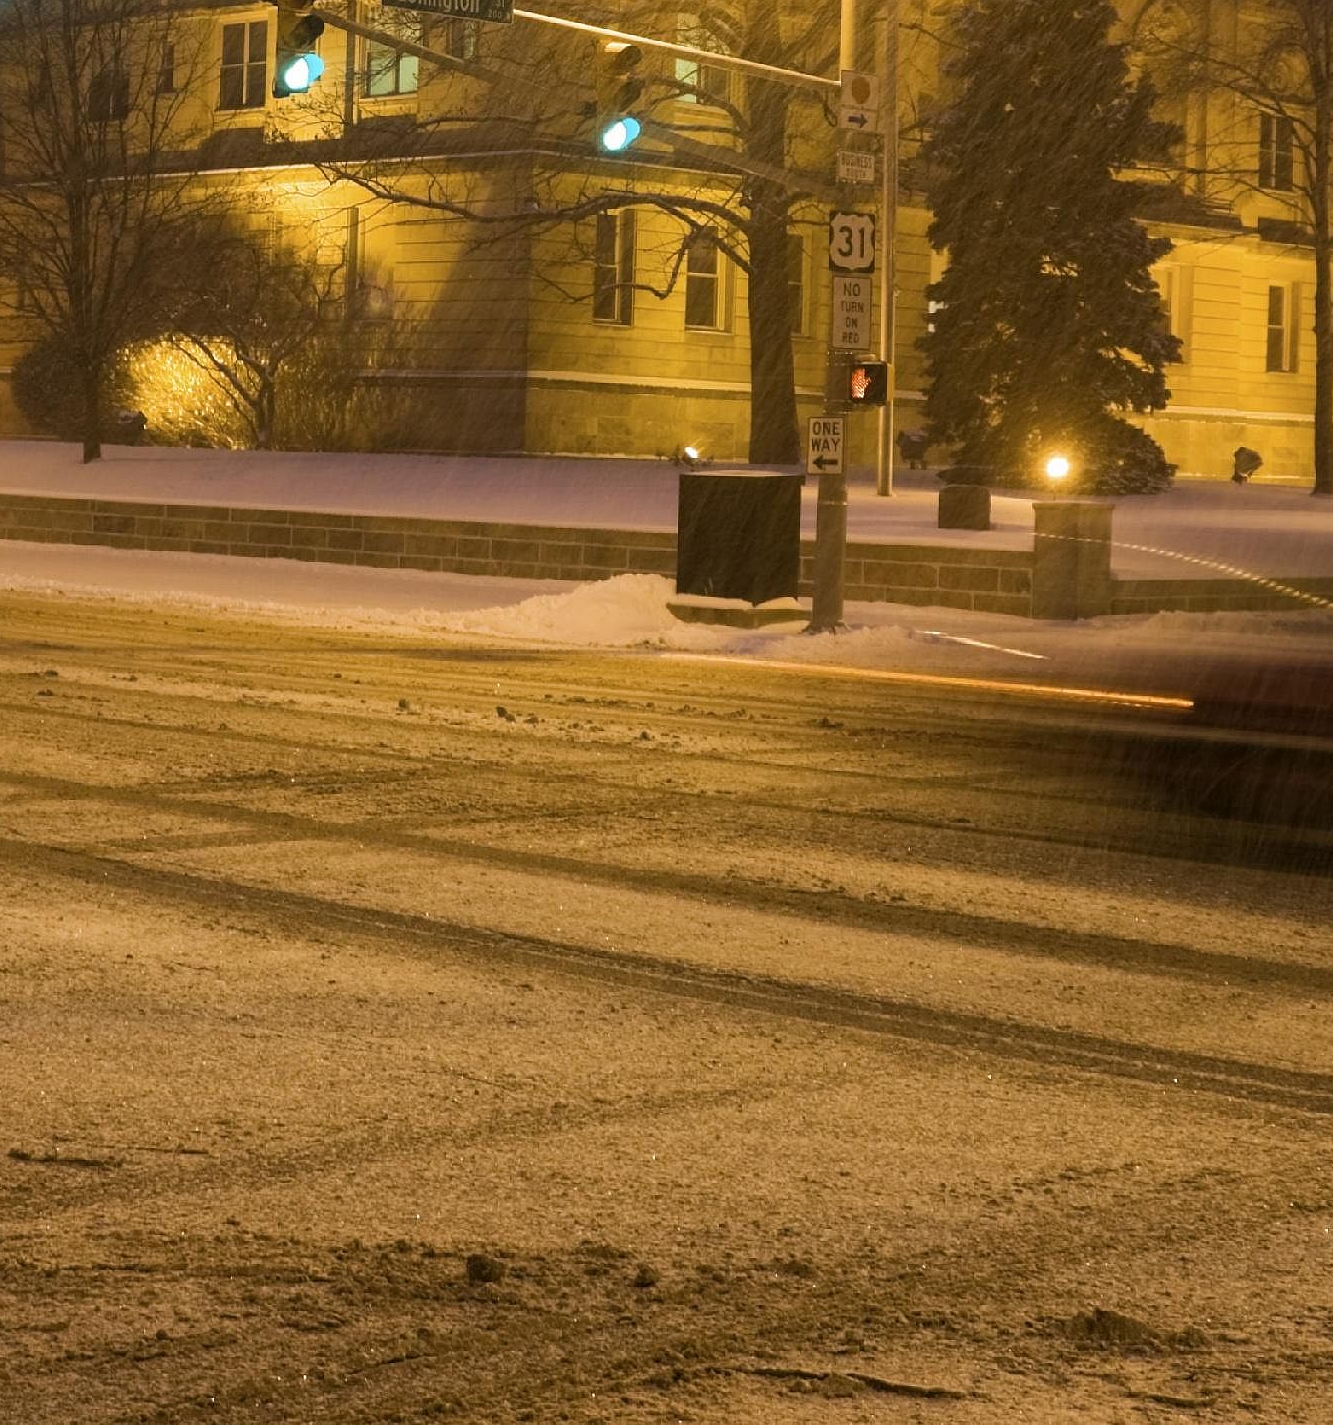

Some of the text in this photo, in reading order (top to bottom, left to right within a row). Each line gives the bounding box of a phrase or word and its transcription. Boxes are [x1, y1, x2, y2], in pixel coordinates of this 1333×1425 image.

[838, 225, 866, 258] 31
[843, 282, 861, 296] NO
[840, 301, 864, 314] TURN
[845, 317, 858, 329] ON
[842, 332, 860, 344] RED
[812, 421, 840, 436] ONE
[811, 438, 841, 452] WAY
